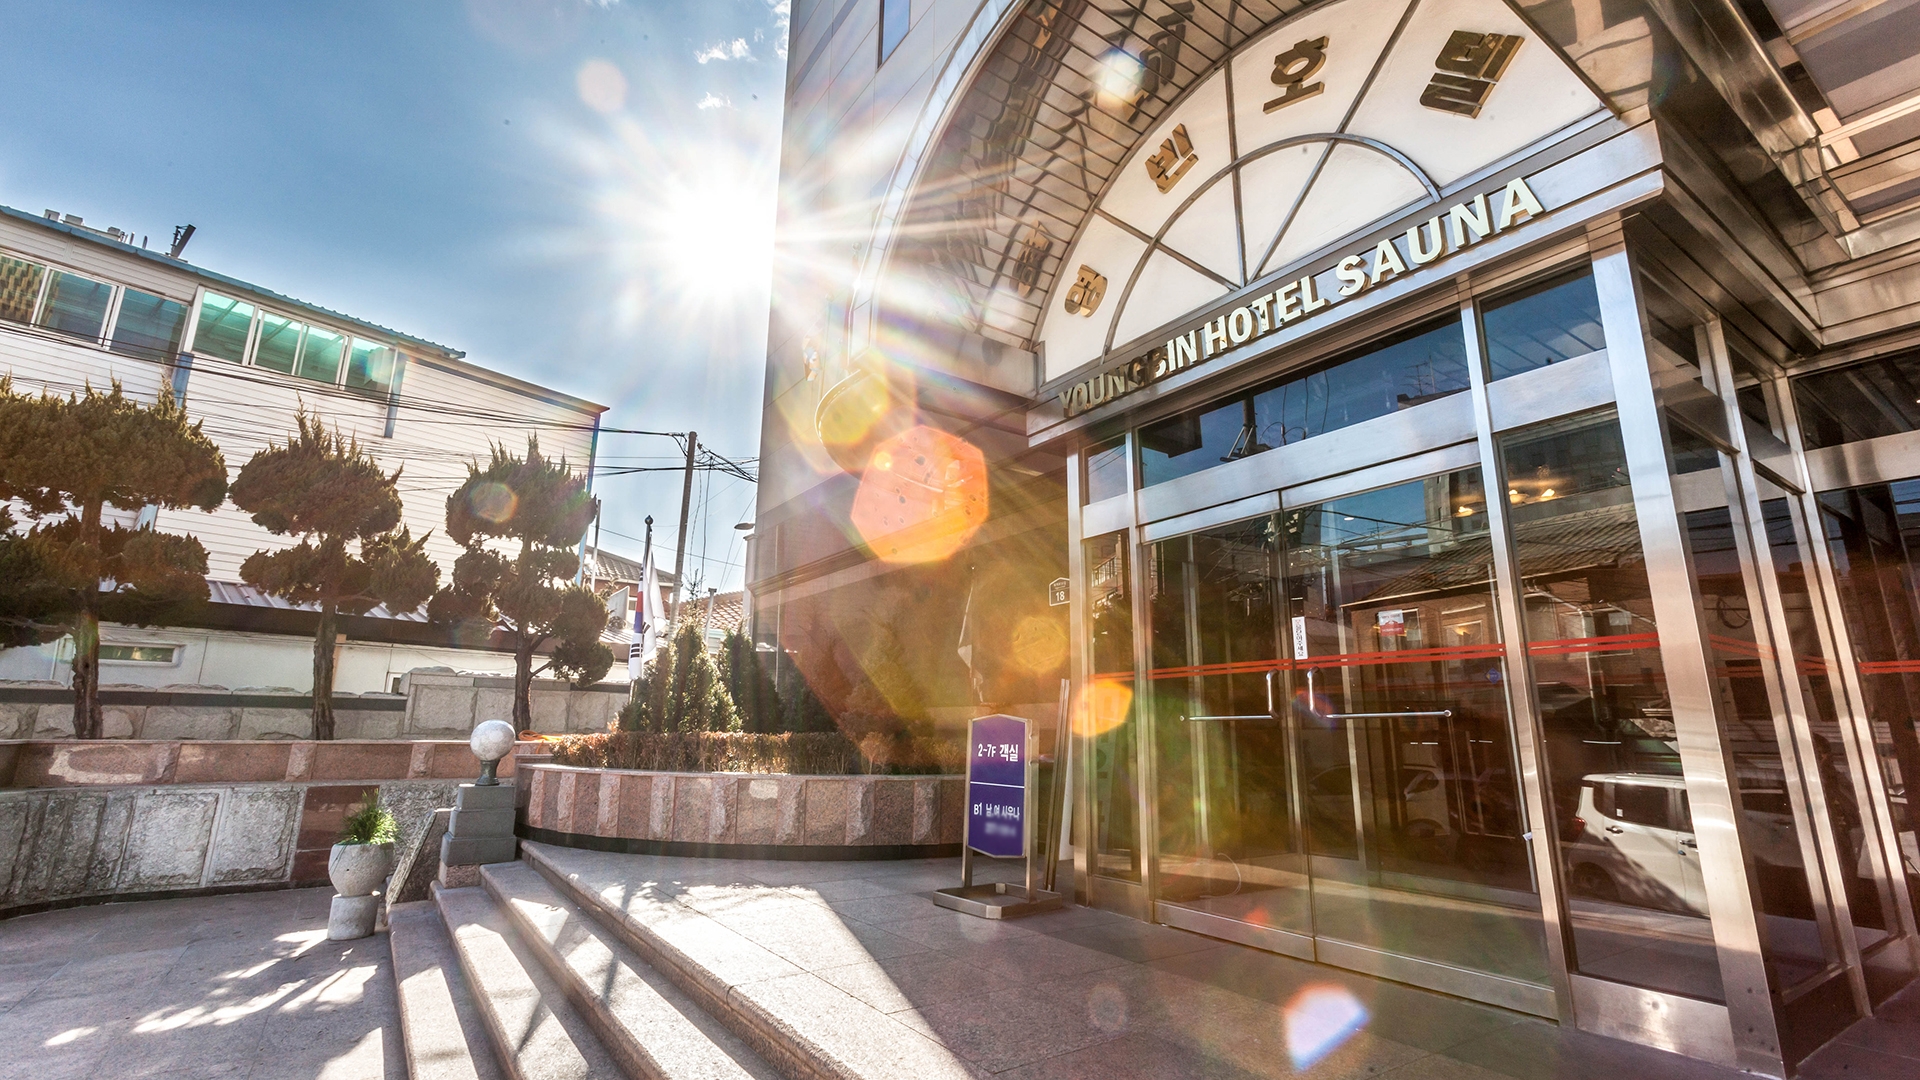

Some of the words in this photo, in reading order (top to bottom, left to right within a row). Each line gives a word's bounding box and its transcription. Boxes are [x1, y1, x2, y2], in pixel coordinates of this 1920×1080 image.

[1058, 329, 1199, 418] YOUNGBIN
[1203, 275, 1328, 357] HOTEL
[1335, 176, 1546, 298] SAUNA
[1055, 590, 1065, 602] 18
[999, 743, 1019, 762] 객실
[973, 802, 983, 816] B1
[1001, 804, 1020, 821] 사우나
